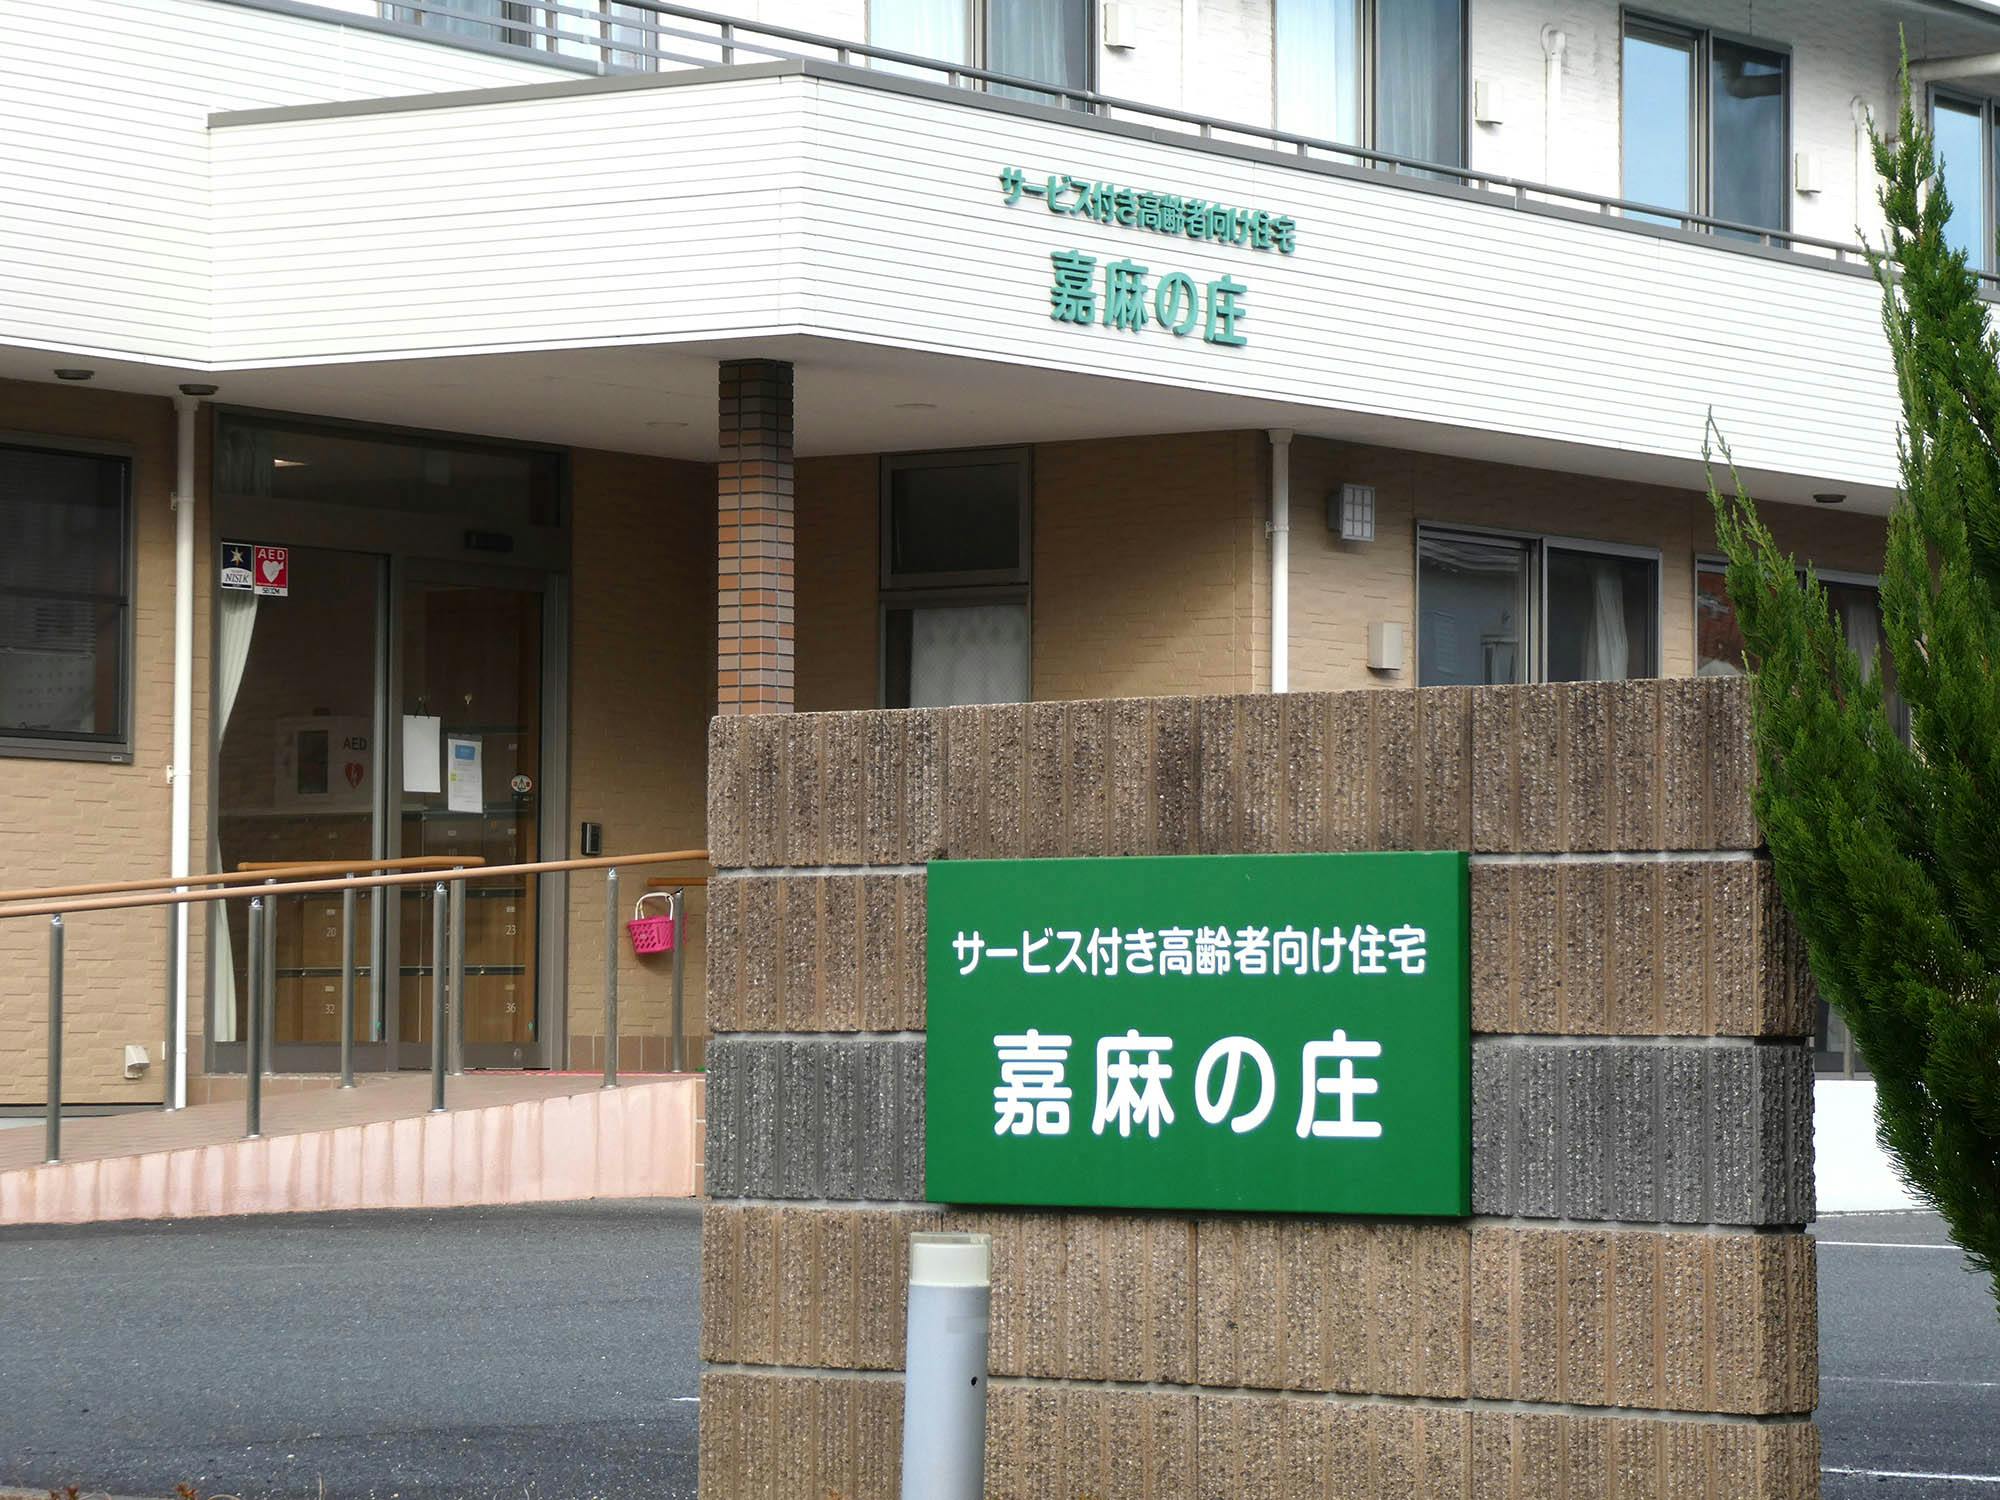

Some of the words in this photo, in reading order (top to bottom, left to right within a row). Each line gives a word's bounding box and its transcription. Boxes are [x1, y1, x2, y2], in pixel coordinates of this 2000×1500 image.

[999, 166, 1296, 254] サービス付き高齢者向け住宅
[1050, 249, 1248, 347] 嘉麻の庄
[258, 549, 285, 560] AED
[343, 736, 367, 751] AED
[326, 927, 337, 938] 20
[505, 924, 516, 936] 23
[953, 924, 1426, 976] サービス付き高齢者向け住宅
[325, 1004, 335, 1015] 32
[505, 1002, 516, 1013] 36
[994, 1029, 1382, 1138] 嘉麻の庄
